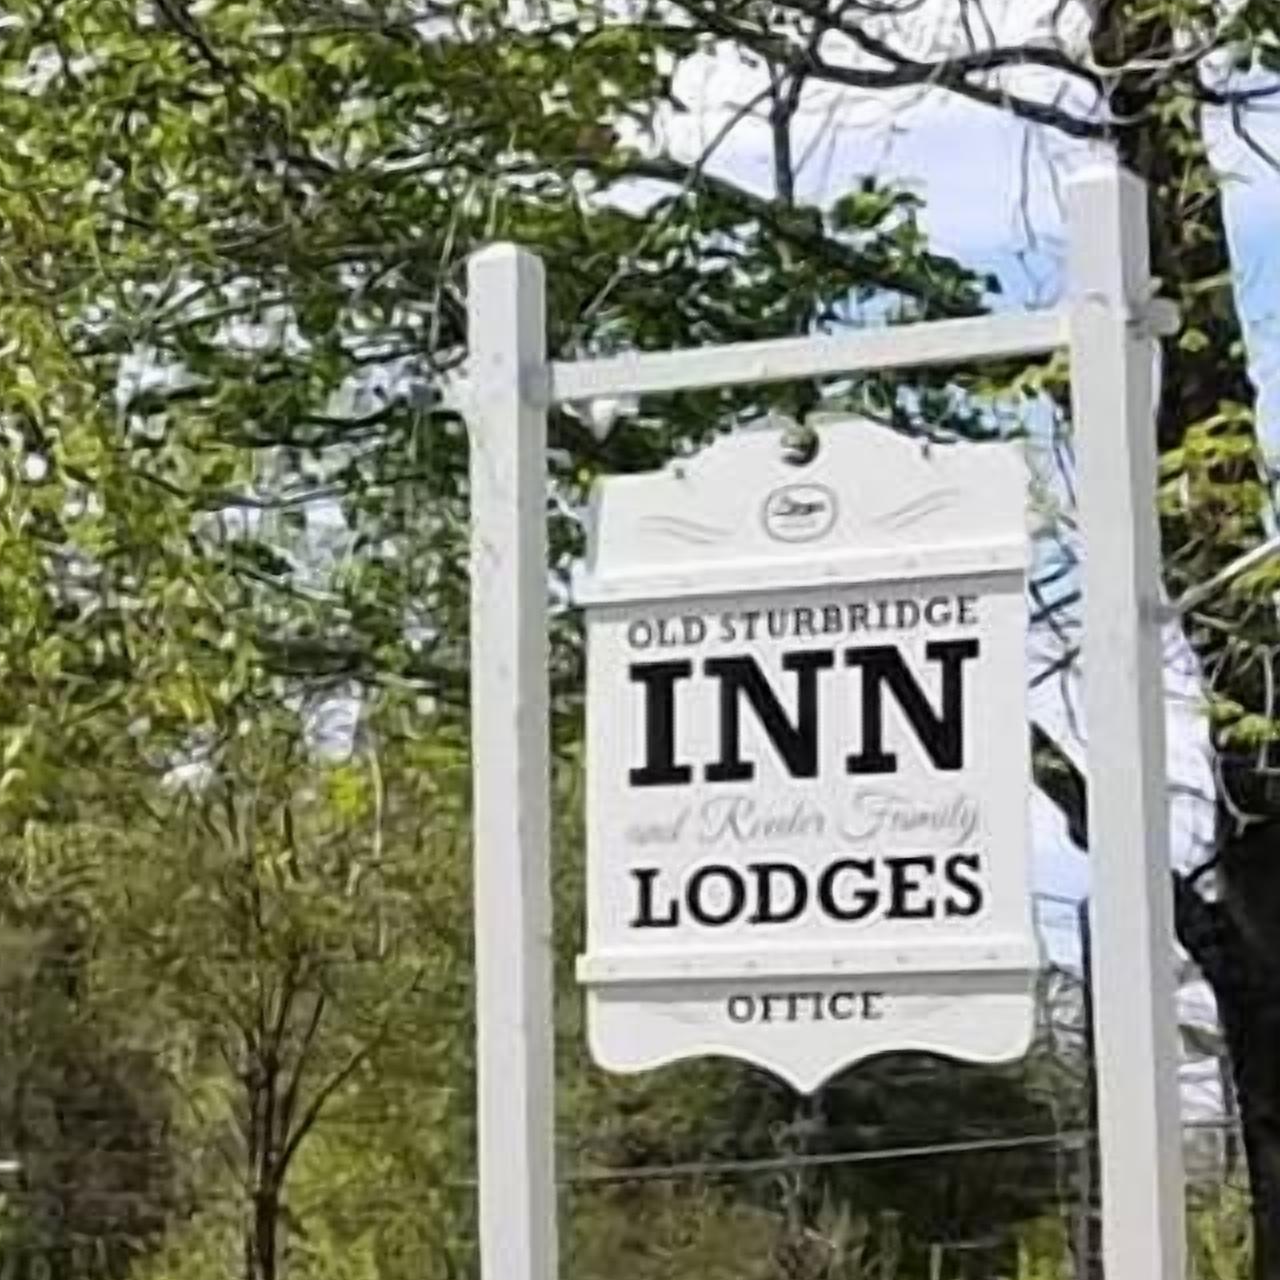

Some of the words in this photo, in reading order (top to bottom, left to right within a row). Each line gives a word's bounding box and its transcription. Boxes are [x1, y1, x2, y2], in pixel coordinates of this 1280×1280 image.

[628, 617, 706, 648] OLD
[721, 595, 980, 641] STURBRIDGE
[629, 639, 980, 787] INN
[629, 854, 983, 928] LODGES
[727, 990, 884, 1022] OFFICE
